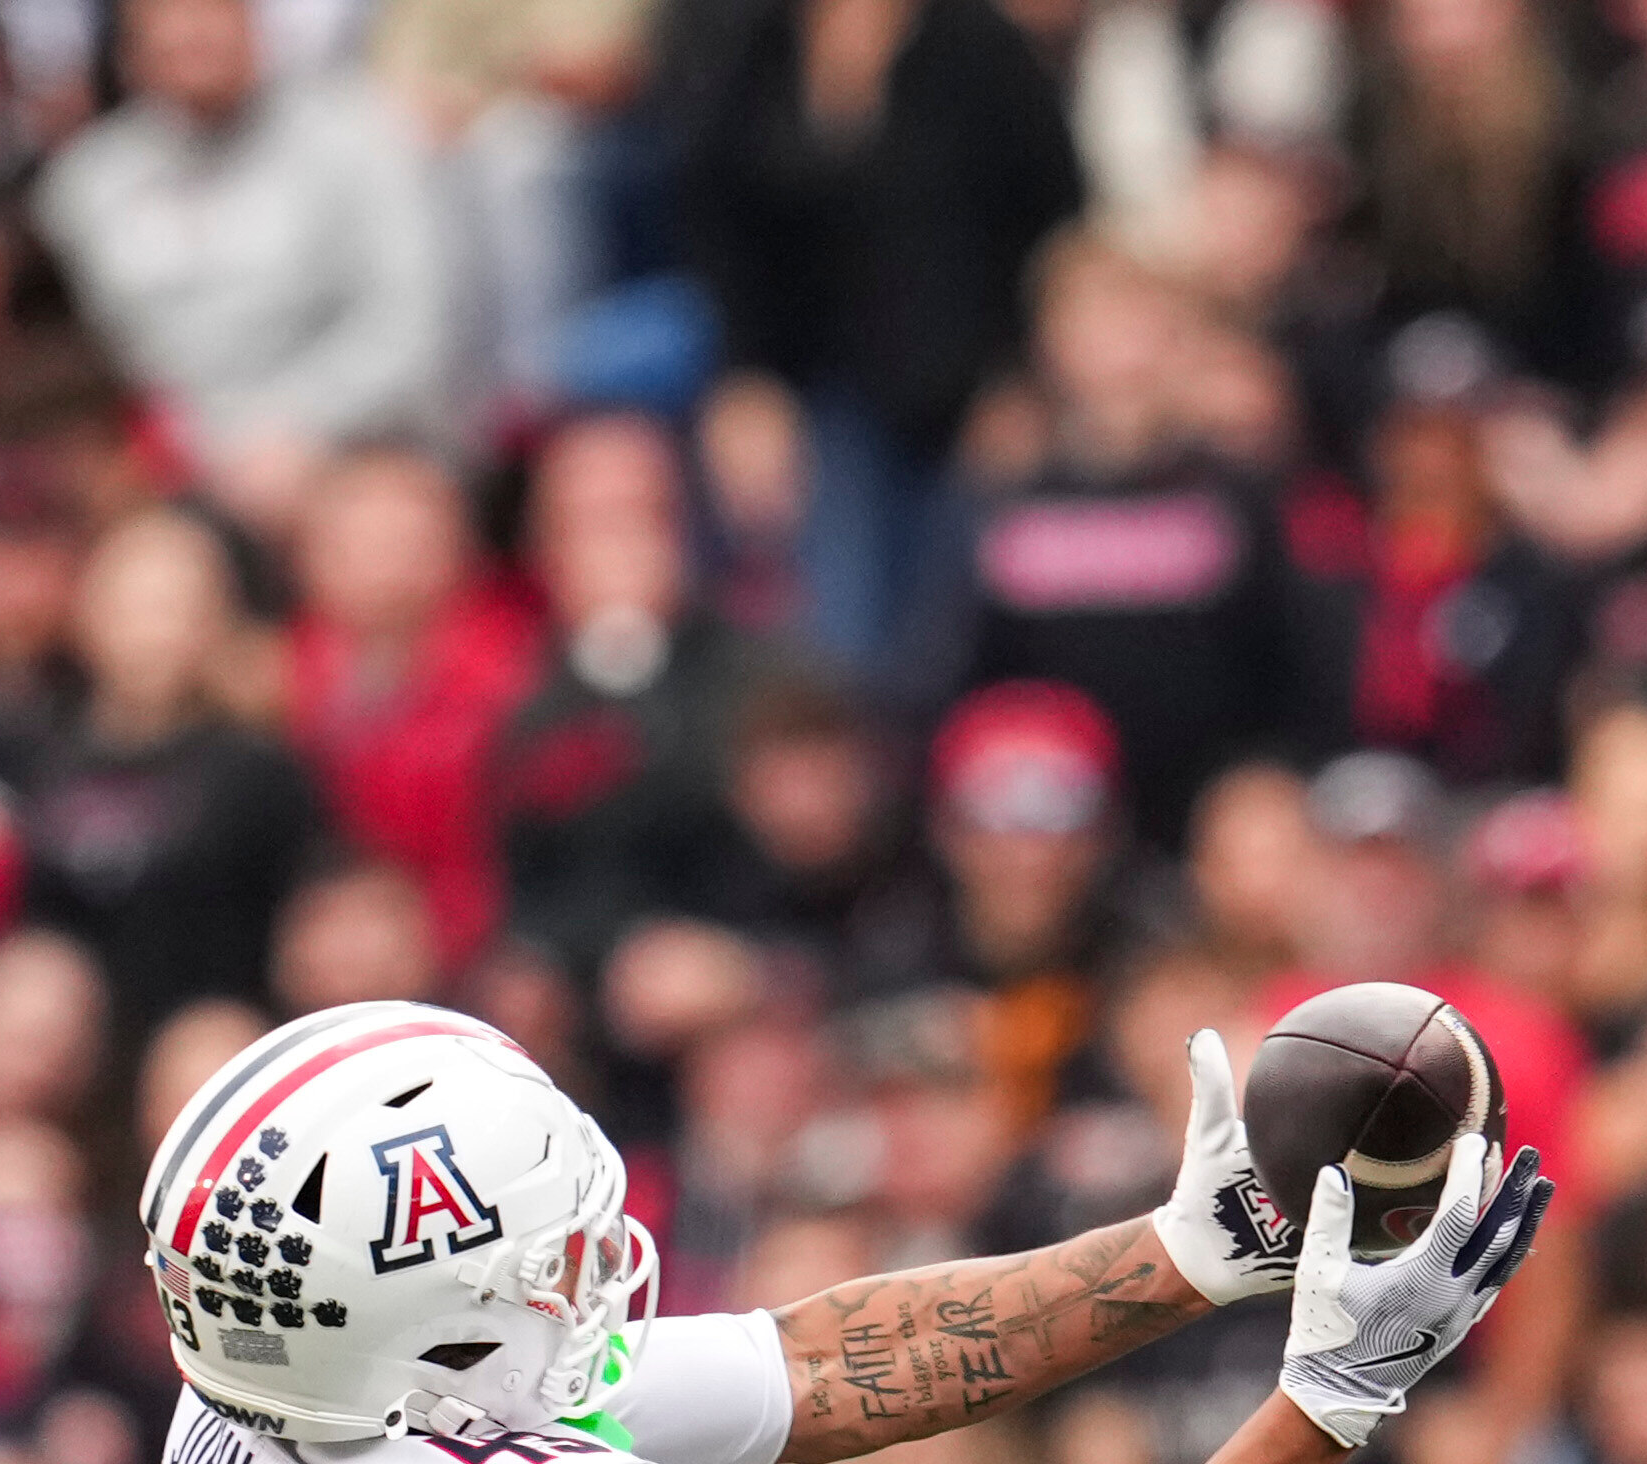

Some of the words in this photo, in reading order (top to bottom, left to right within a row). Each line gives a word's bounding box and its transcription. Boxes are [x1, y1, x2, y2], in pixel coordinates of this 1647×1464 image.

[369, 1124, 504, 1276] A
[841, 1323, 908, 1420] FAITH
[908, 1346, 934, 1404] bigger
[929, 1339, 957, 1381] your
[935, 1286, 1015, 1415] FEAR
